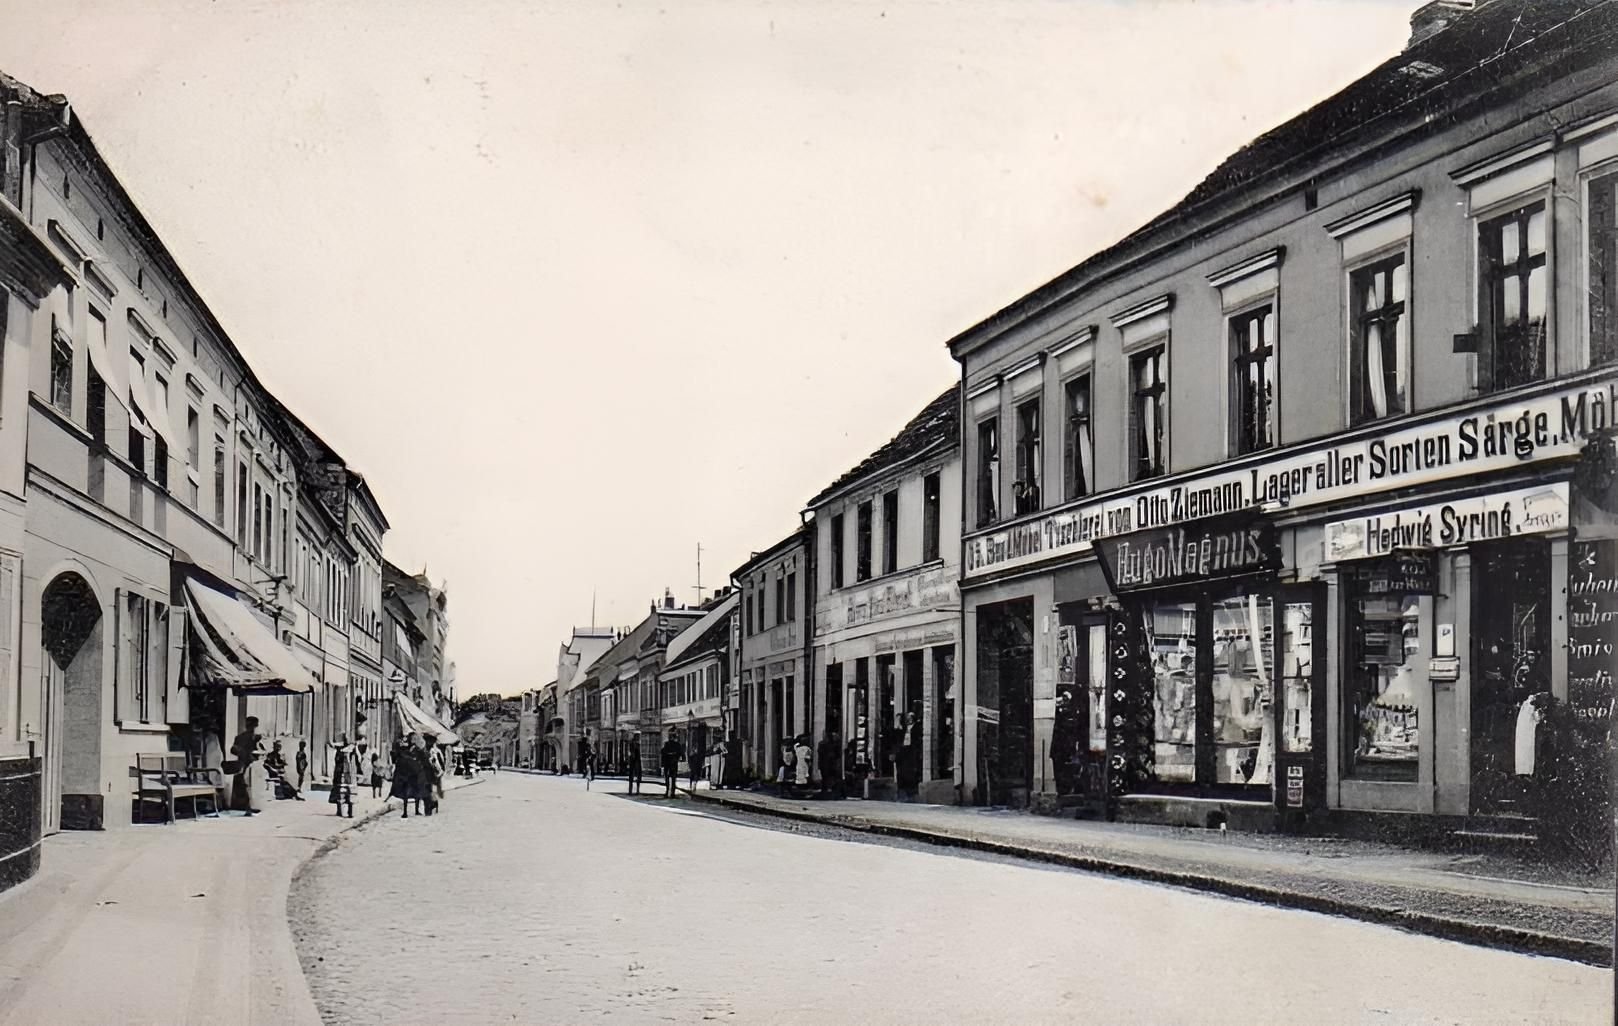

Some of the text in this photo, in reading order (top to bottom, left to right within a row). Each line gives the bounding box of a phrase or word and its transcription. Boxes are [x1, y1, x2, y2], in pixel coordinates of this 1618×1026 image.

[1251, 465, 1312, 507] Lager
[1315, 449, 1363, 490] aller
[1369, 434, 1450, 480] Sorten
